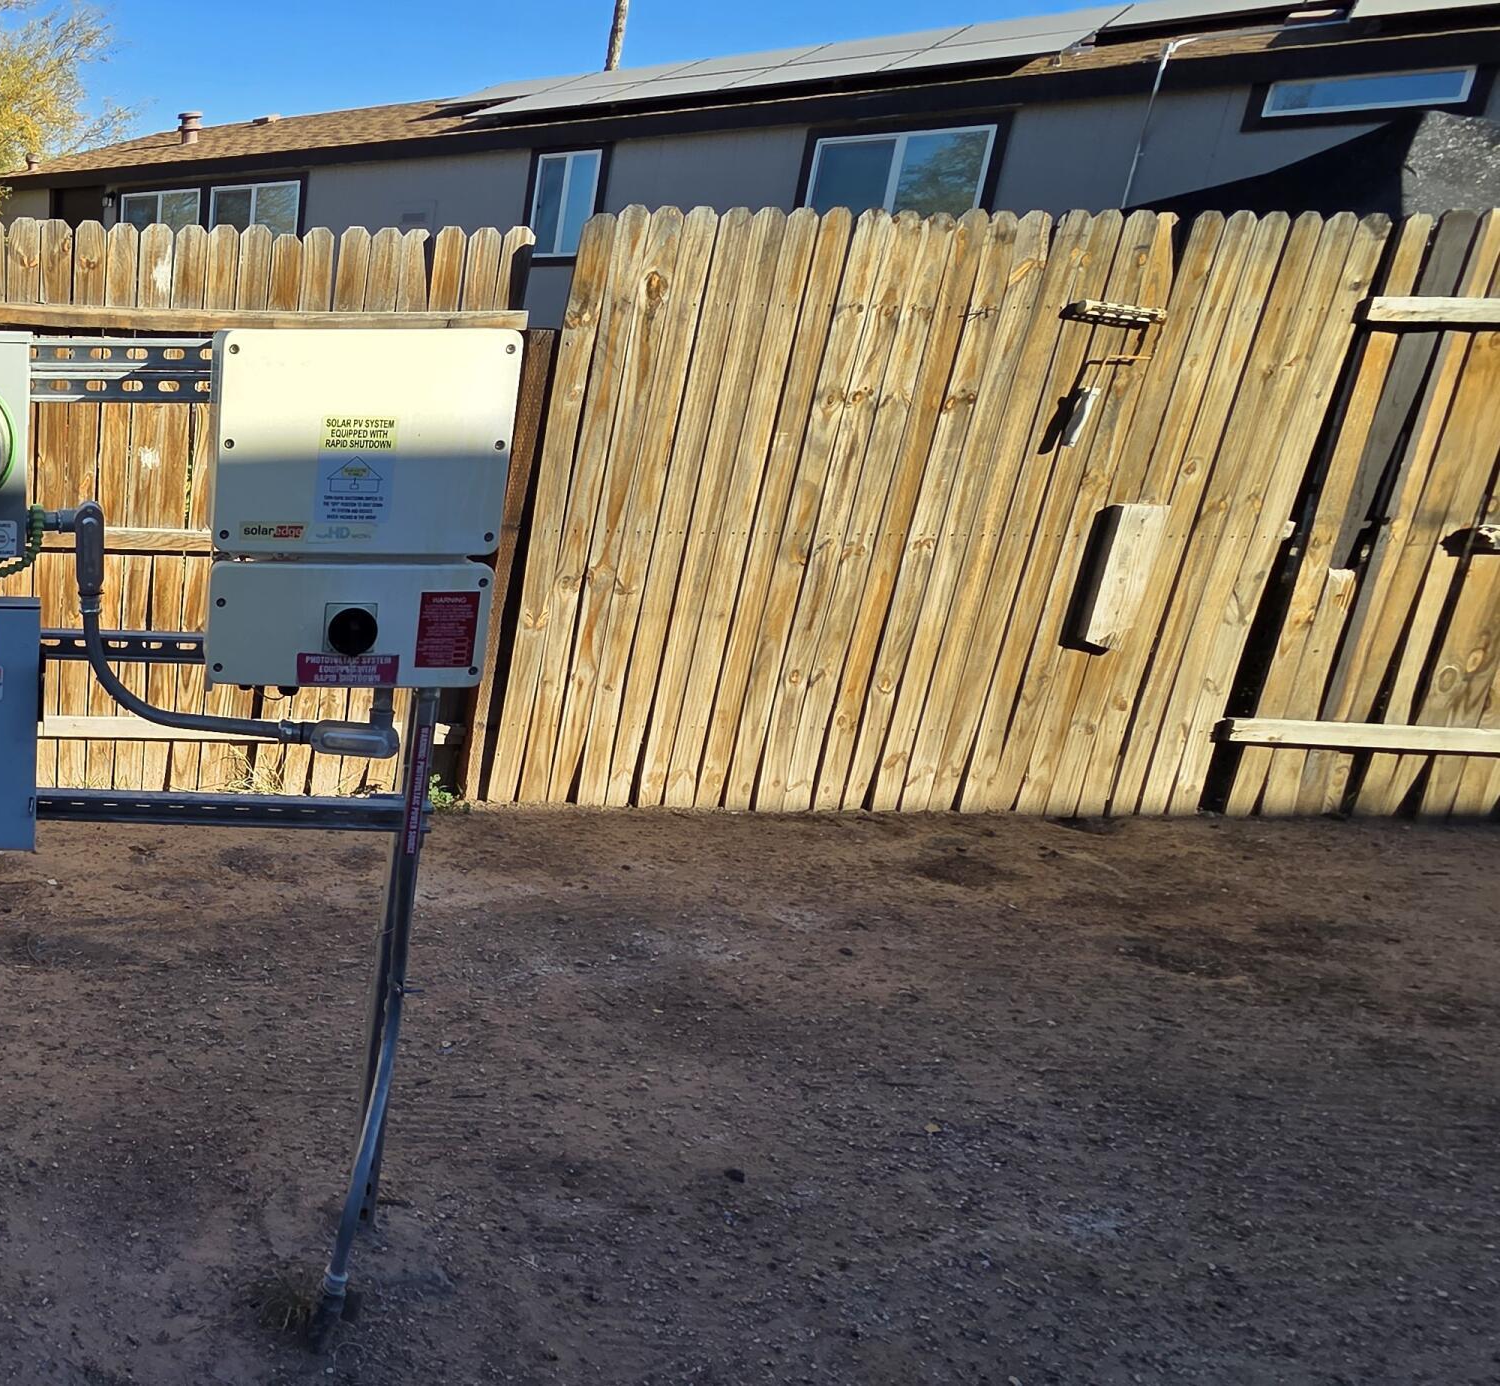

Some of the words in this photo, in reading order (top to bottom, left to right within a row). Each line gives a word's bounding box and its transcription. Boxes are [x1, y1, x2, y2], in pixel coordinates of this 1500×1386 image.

[326, 419, 352, 428] SOLAR
[353, 419, 364, 428] PV
[364, 419, 395, 429] SYSTEM
[330, 429, 368, 438] EQUIPPED
[369, 430, 389, 439] WITH
[325, 439, 348, 448] RAPID
[349, 440, 392, 449] SHUTDOWN
